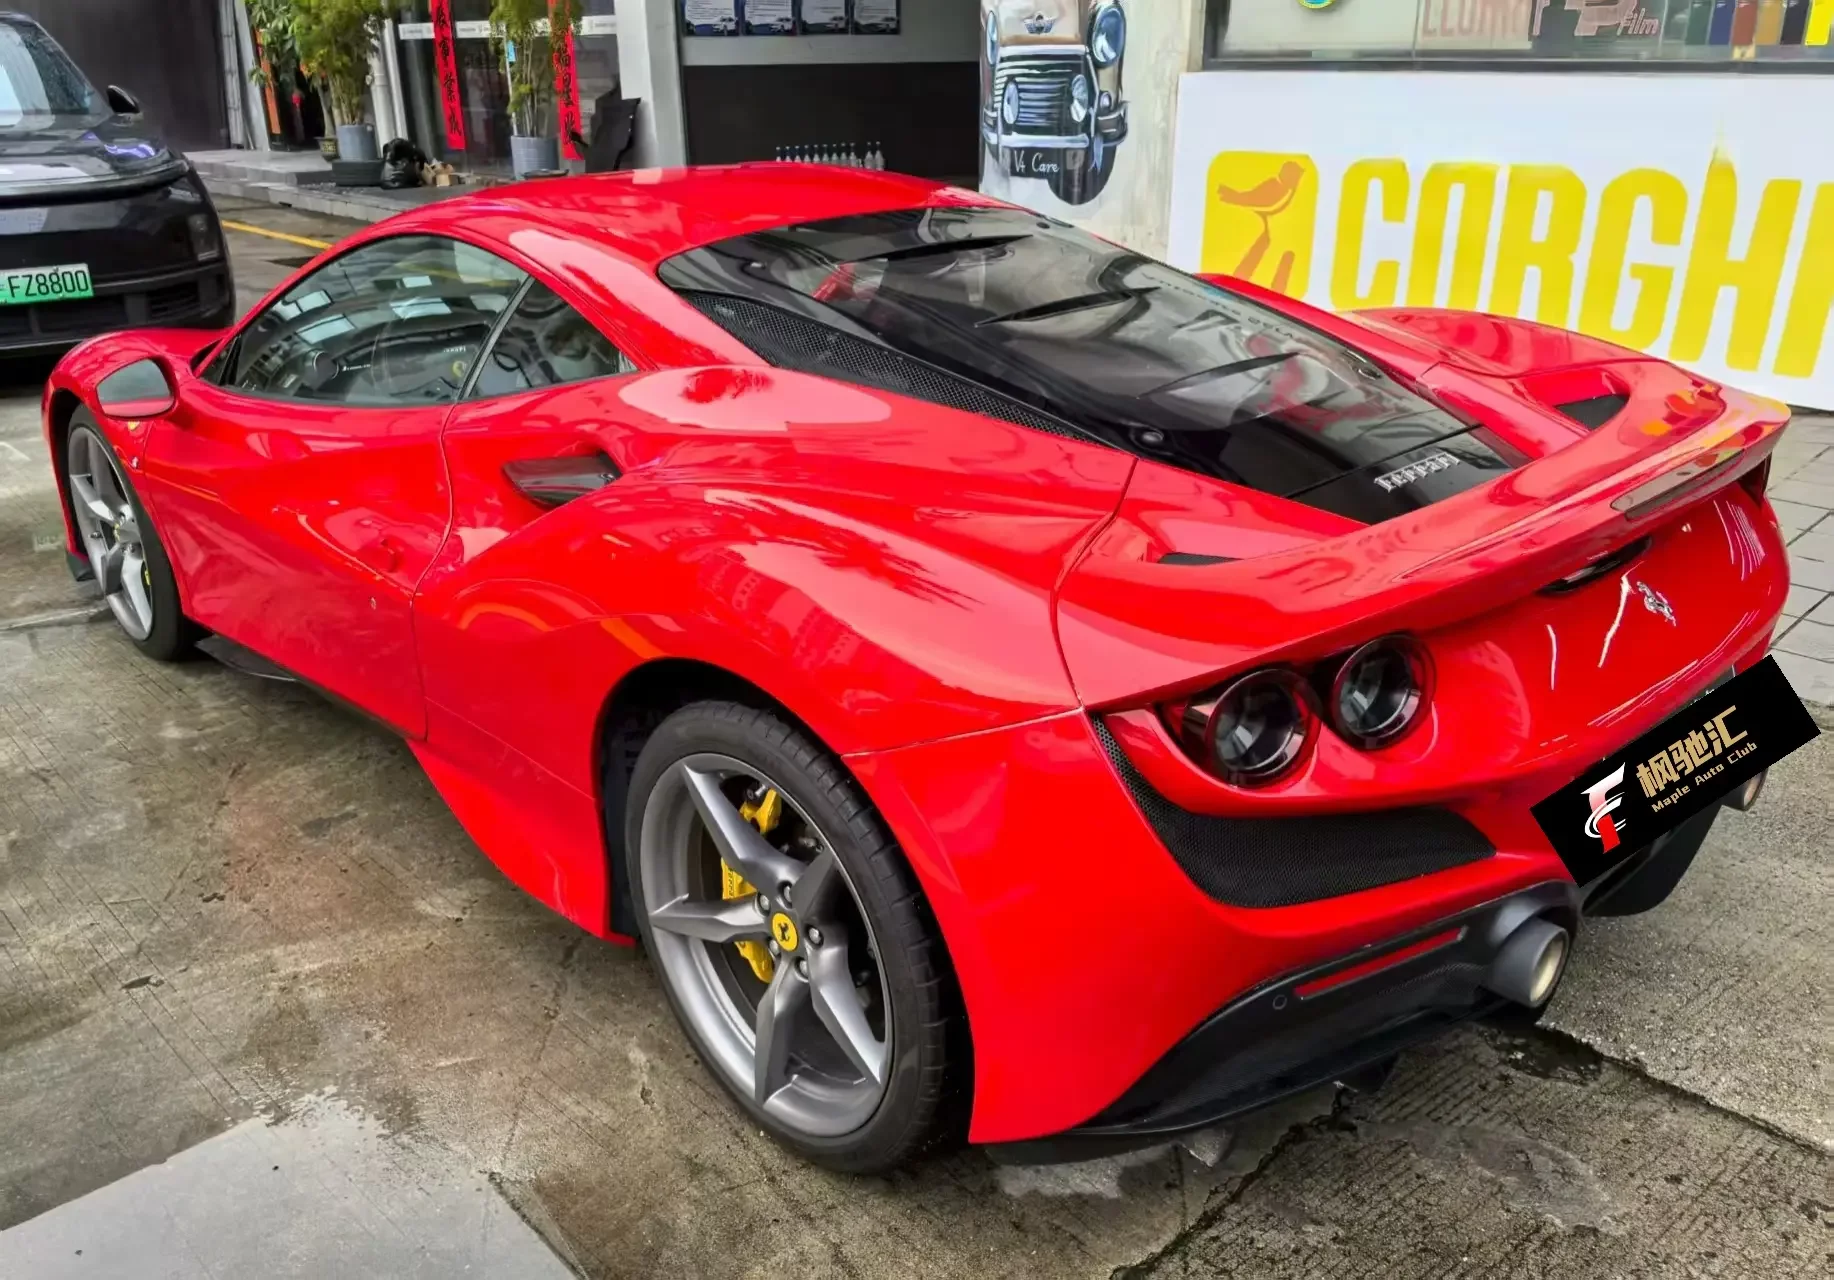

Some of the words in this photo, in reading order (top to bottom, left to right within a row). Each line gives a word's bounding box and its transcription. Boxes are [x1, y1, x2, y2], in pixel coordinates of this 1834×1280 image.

[1616, 7, 1660, 37] Film
[1031, 152, 1059, 173] Care
[1374, 451, 1461, 493] Ferrari
